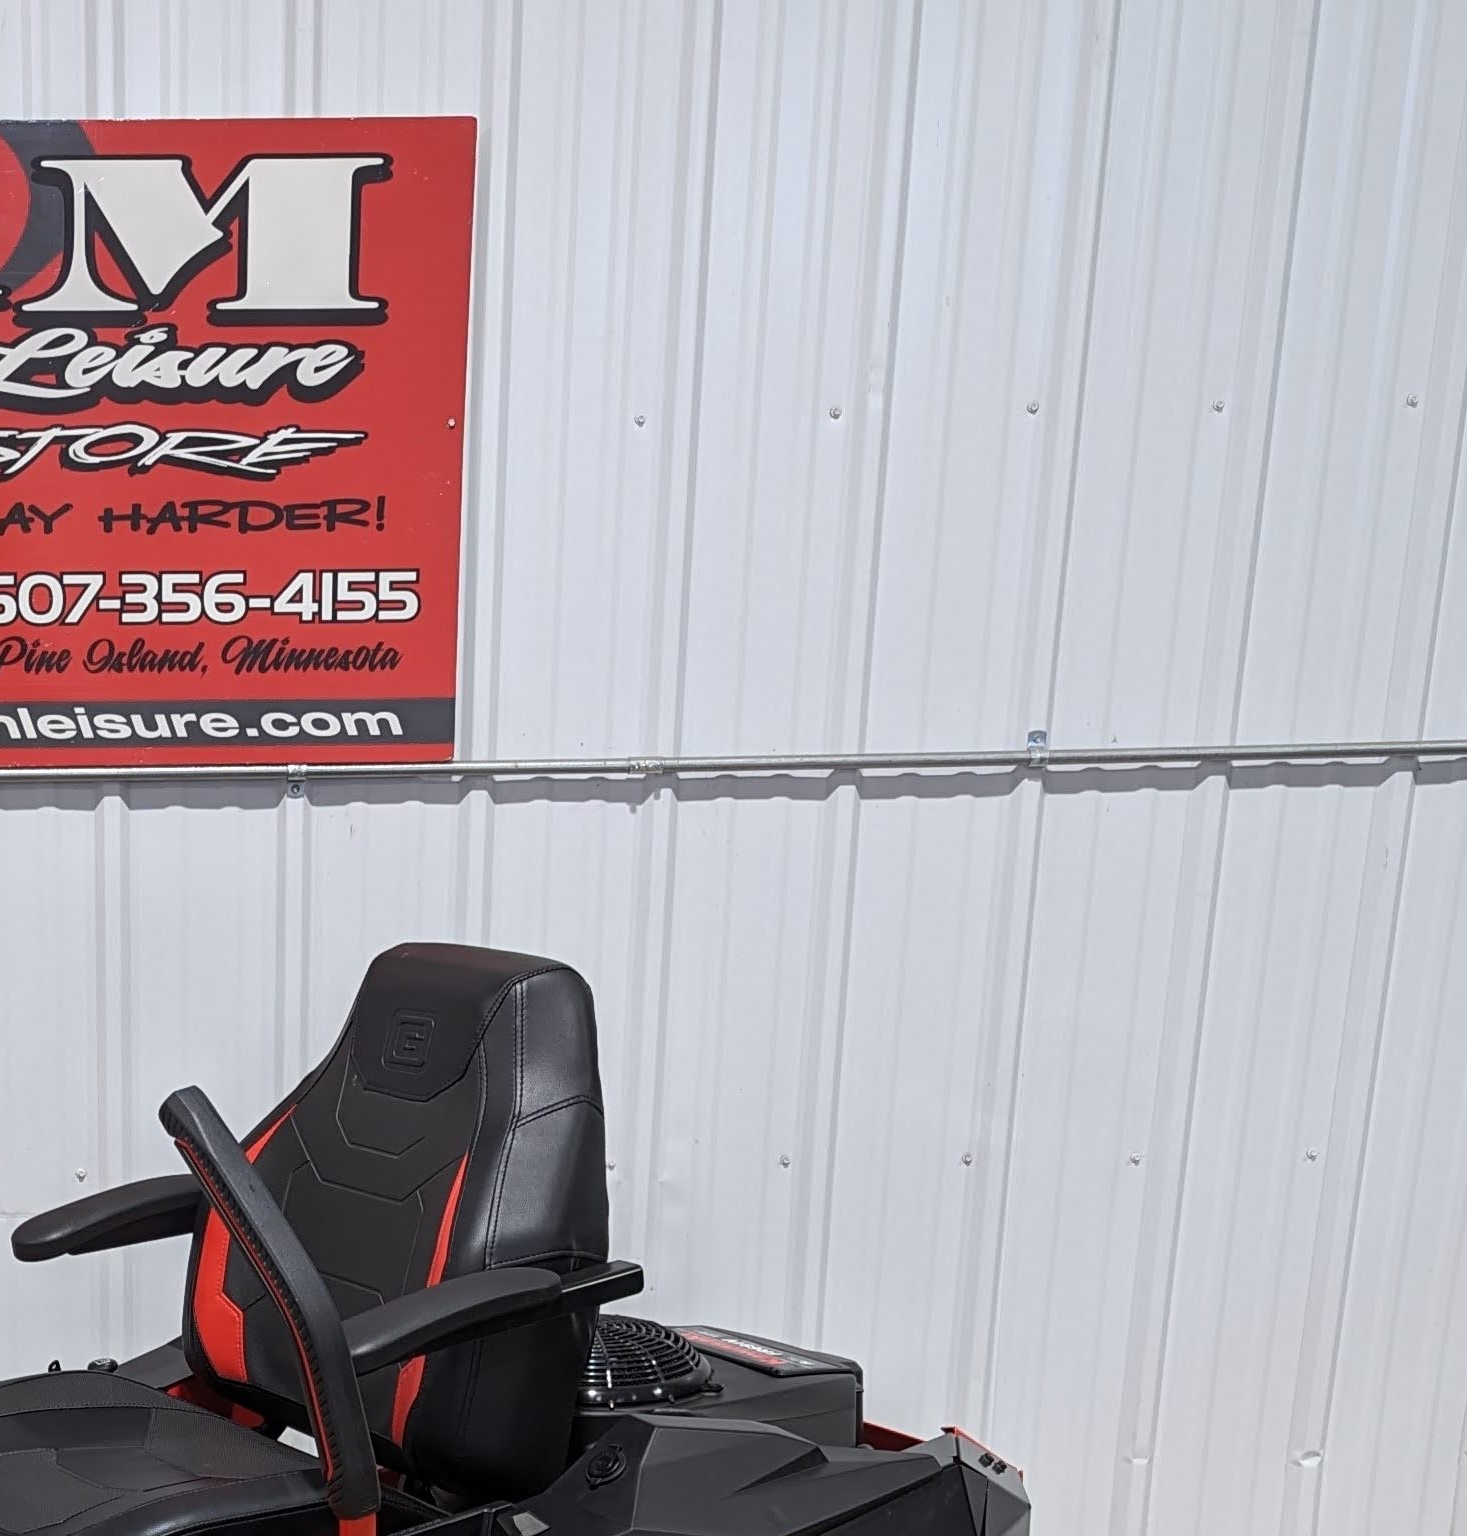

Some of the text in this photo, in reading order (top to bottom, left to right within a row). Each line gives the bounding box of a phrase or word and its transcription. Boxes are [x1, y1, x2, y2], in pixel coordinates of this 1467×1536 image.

[97, 495, 387, 536] HARDER!
[82, 637, 209, 678] Island,
[221, 634, 403, 676] Minnesota
